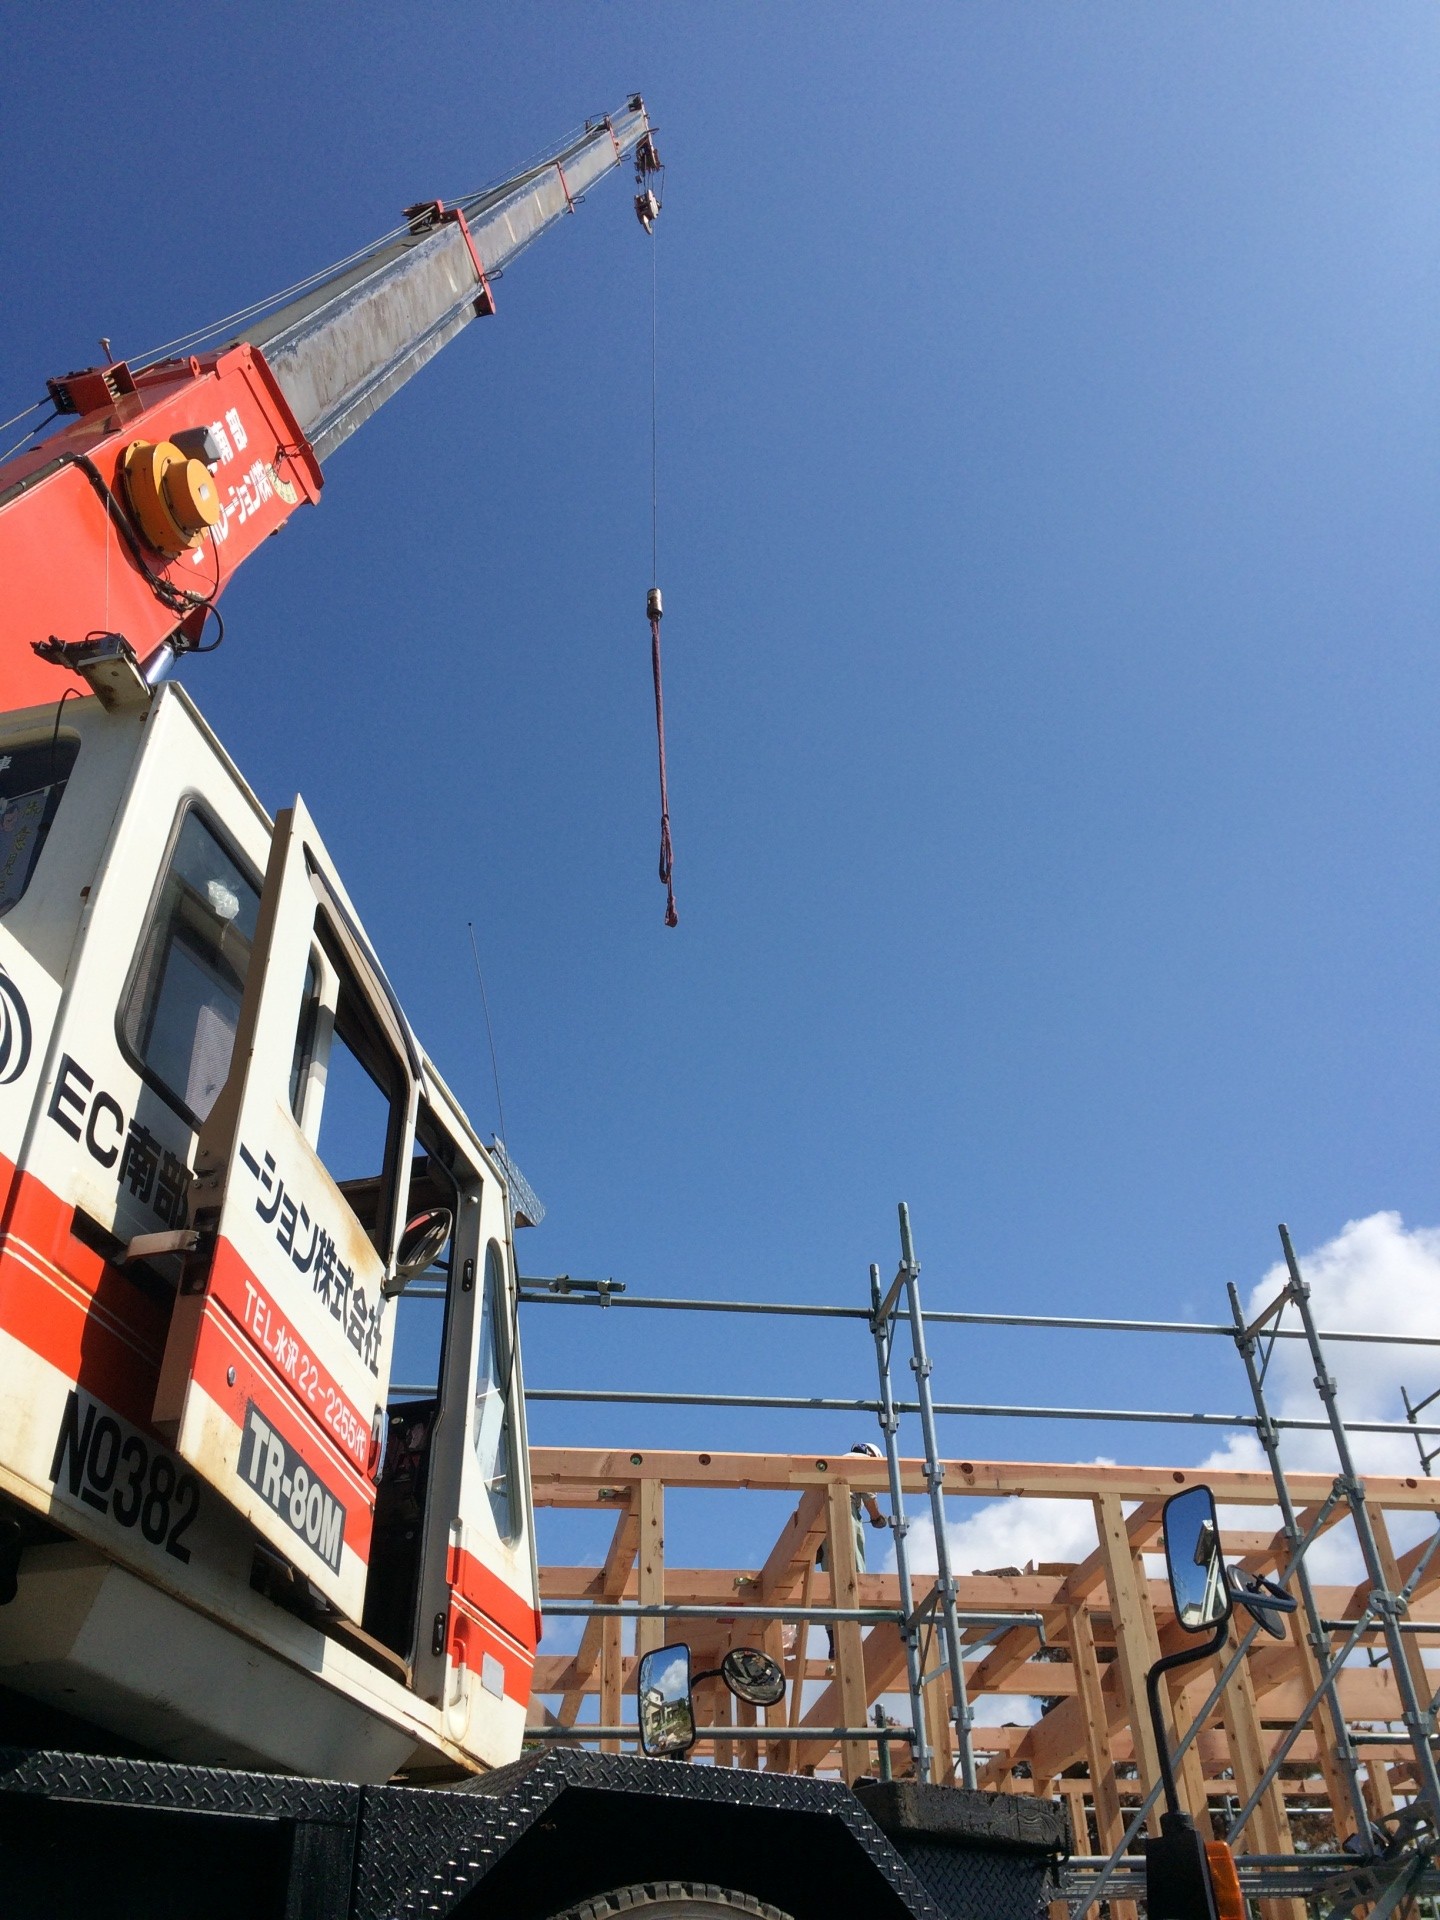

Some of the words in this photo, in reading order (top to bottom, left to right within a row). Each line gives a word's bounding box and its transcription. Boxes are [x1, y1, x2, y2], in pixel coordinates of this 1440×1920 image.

[239, 1142, 383, 1379] ーション株式会社
[249, 1410, 343, 1568] TR-80M
